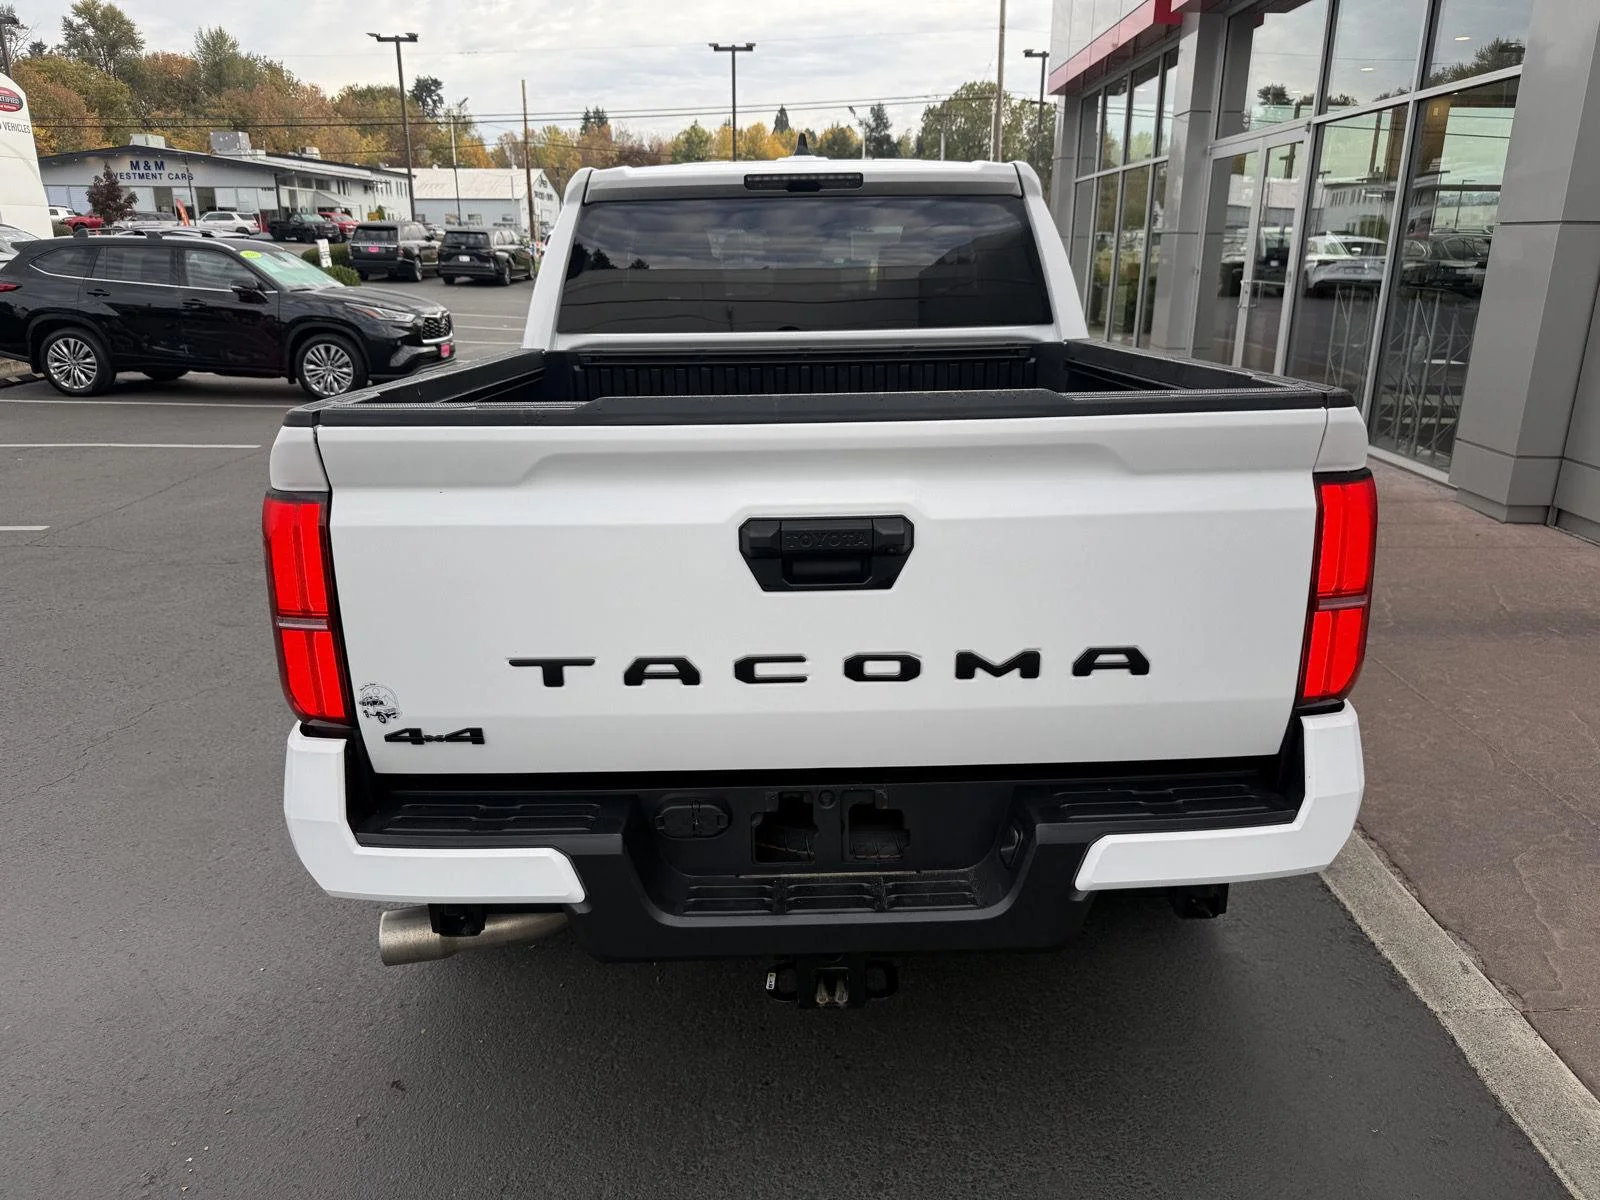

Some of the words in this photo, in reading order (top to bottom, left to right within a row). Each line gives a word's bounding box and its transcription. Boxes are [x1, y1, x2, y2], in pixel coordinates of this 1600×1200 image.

[2, 121, 31, 134] VEHICLES
[130, 160, 140, 171] M
[143, 160, 151, 171] &
[155, 160, 165, 171] M
[112, 172, 163, 180] VESTMENT
[168, 173, 194, 181] CARS
[785, 531, 869, 548] TOYOTA
[508, 646, 1151, 688] TACOMA
